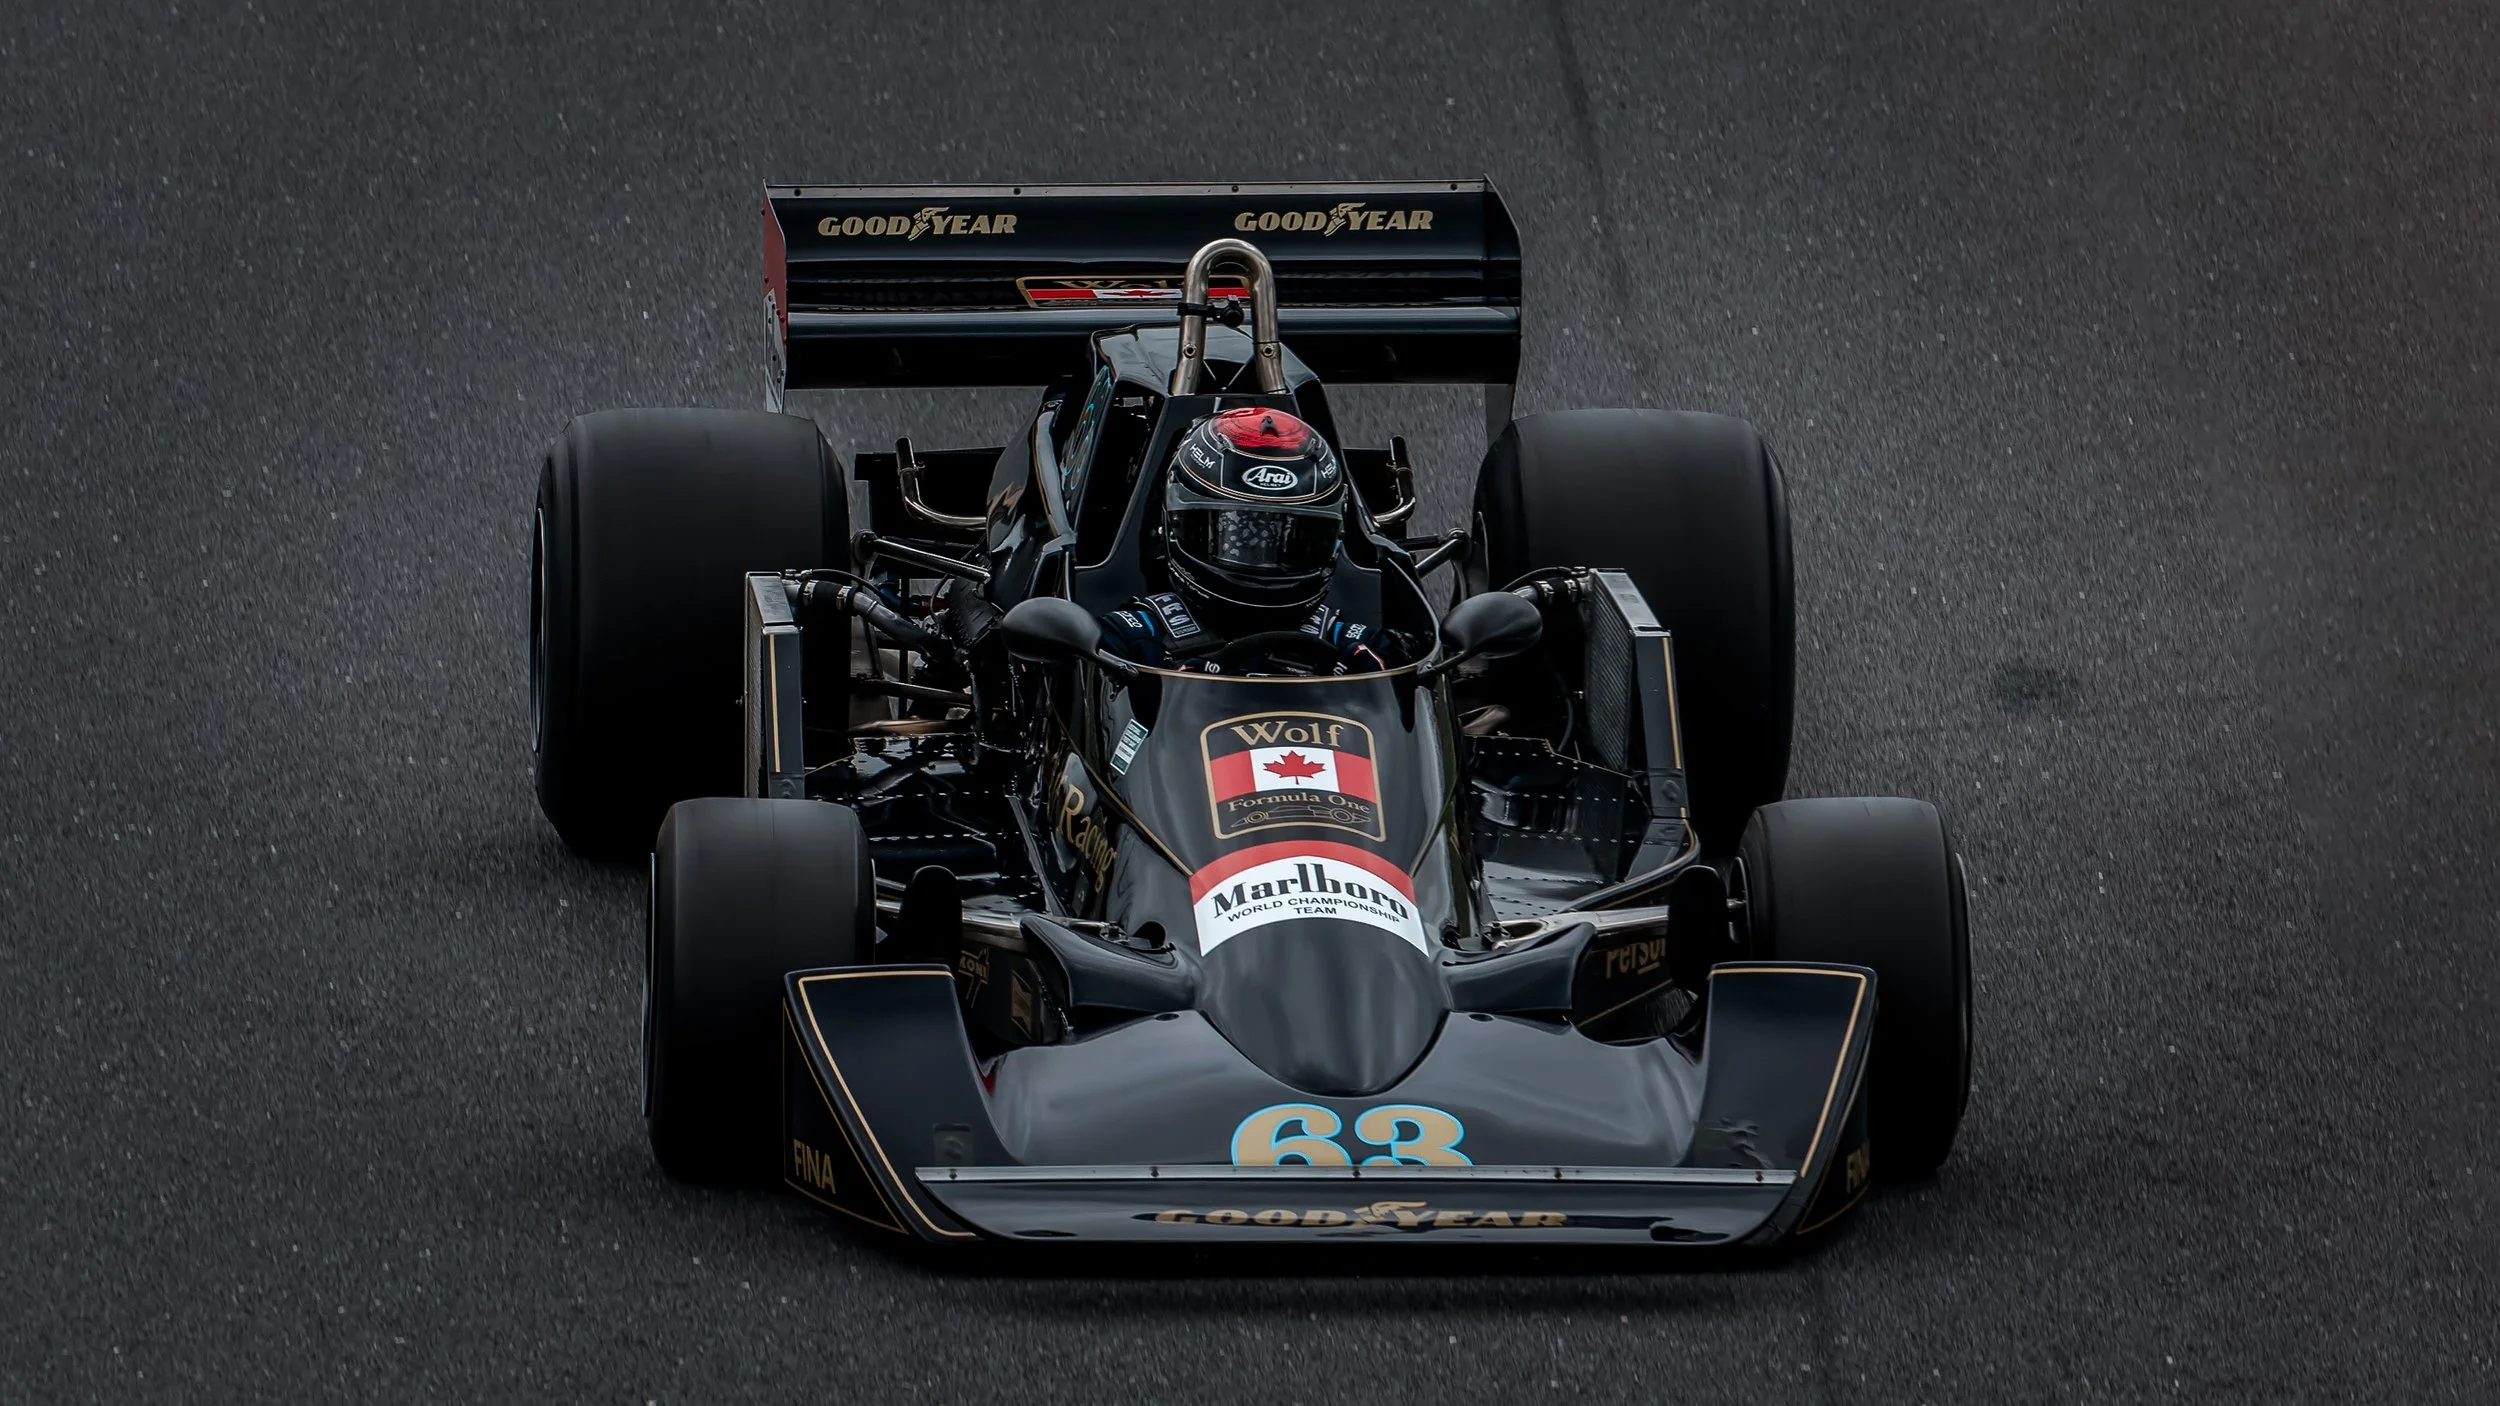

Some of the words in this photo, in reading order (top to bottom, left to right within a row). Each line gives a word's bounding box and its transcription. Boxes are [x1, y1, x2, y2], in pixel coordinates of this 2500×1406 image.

[1247, 467, 1292, 484] Arai
[1230, 720, 1344, 748] Wolf
[1228, 791, 1321, 812] Formula
[1328, 794, 1370, 814] One
[1212, 863, 1409, 919] Marlboro
[1227, 900, 1283, 922] WORLD
[1288, 896, 1400, 923] CHAMPIONSHIP
[1293, 906, 1337, 915] TEAM
[1231, 1101, 1475, 1167] 63
[793, 1137, 836, 1195] FINA
